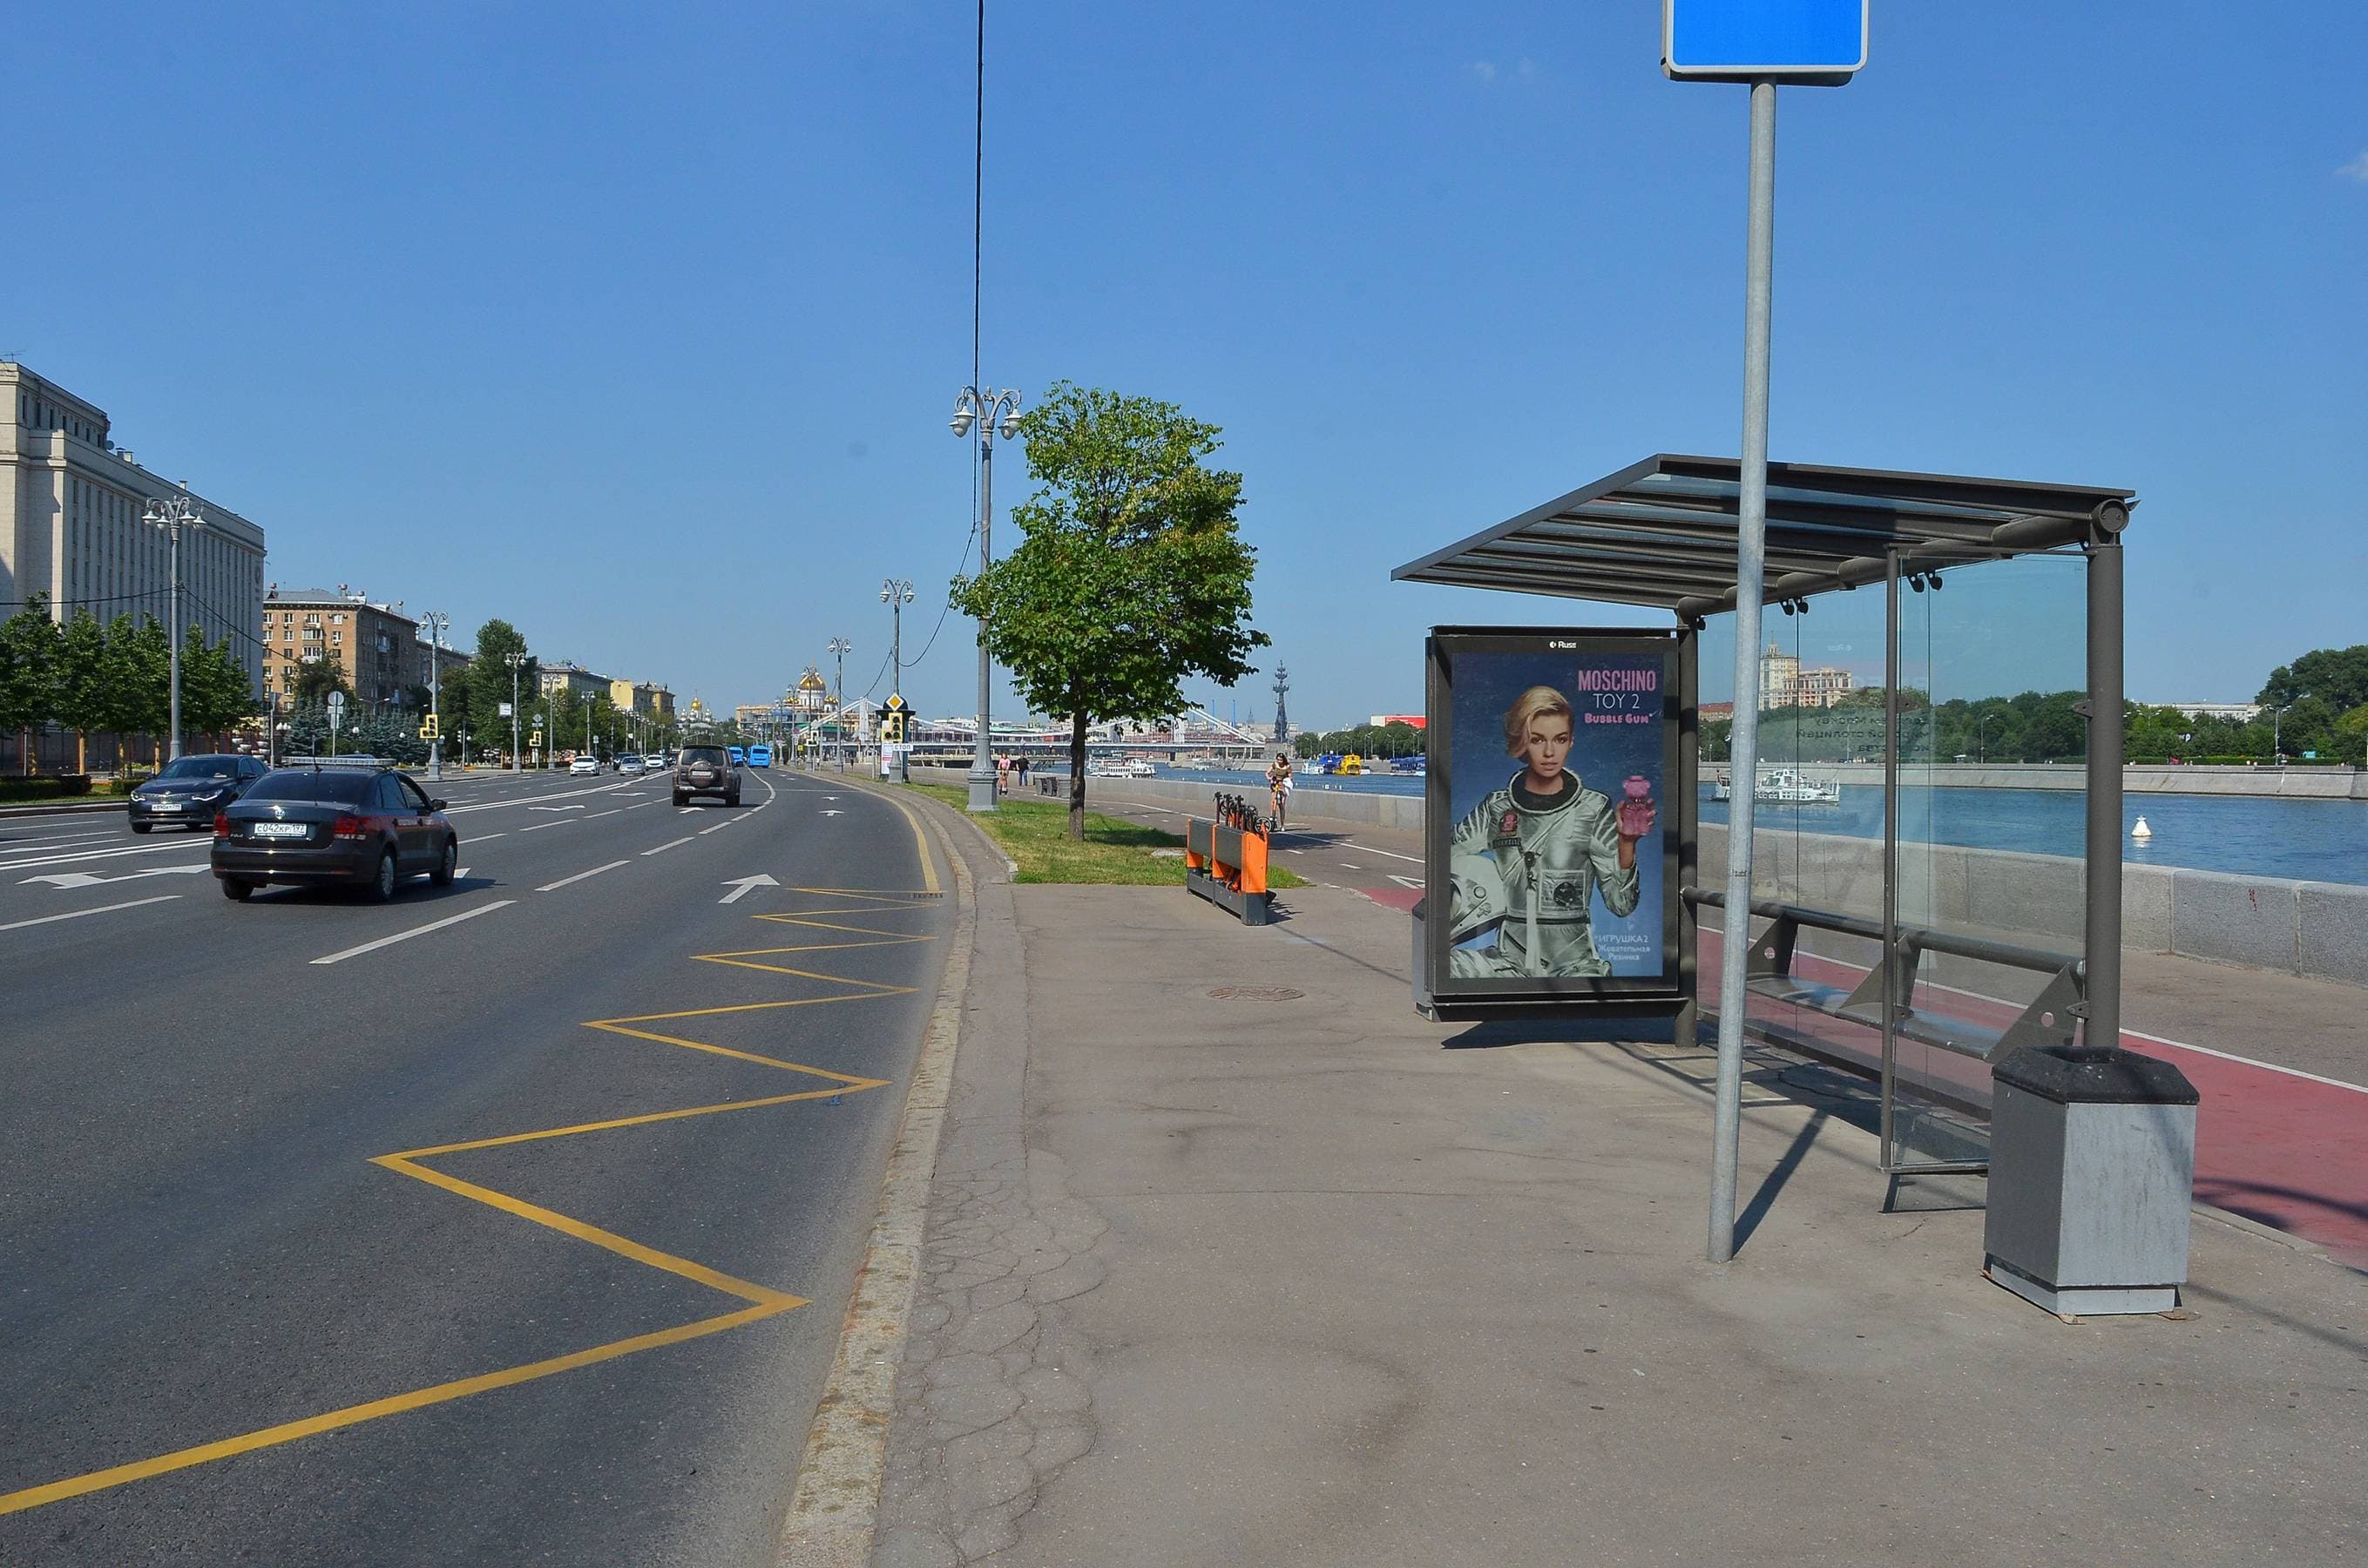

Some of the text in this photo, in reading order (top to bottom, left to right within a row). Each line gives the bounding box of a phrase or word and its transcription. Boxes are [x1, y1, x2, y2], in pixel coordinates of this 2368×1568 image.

[1578, 670, 1656, 692] MOSCHINO
[1593, 693, 1641, 709] TOY 2
[1585, 713, 1623, 724] BUBBLE
